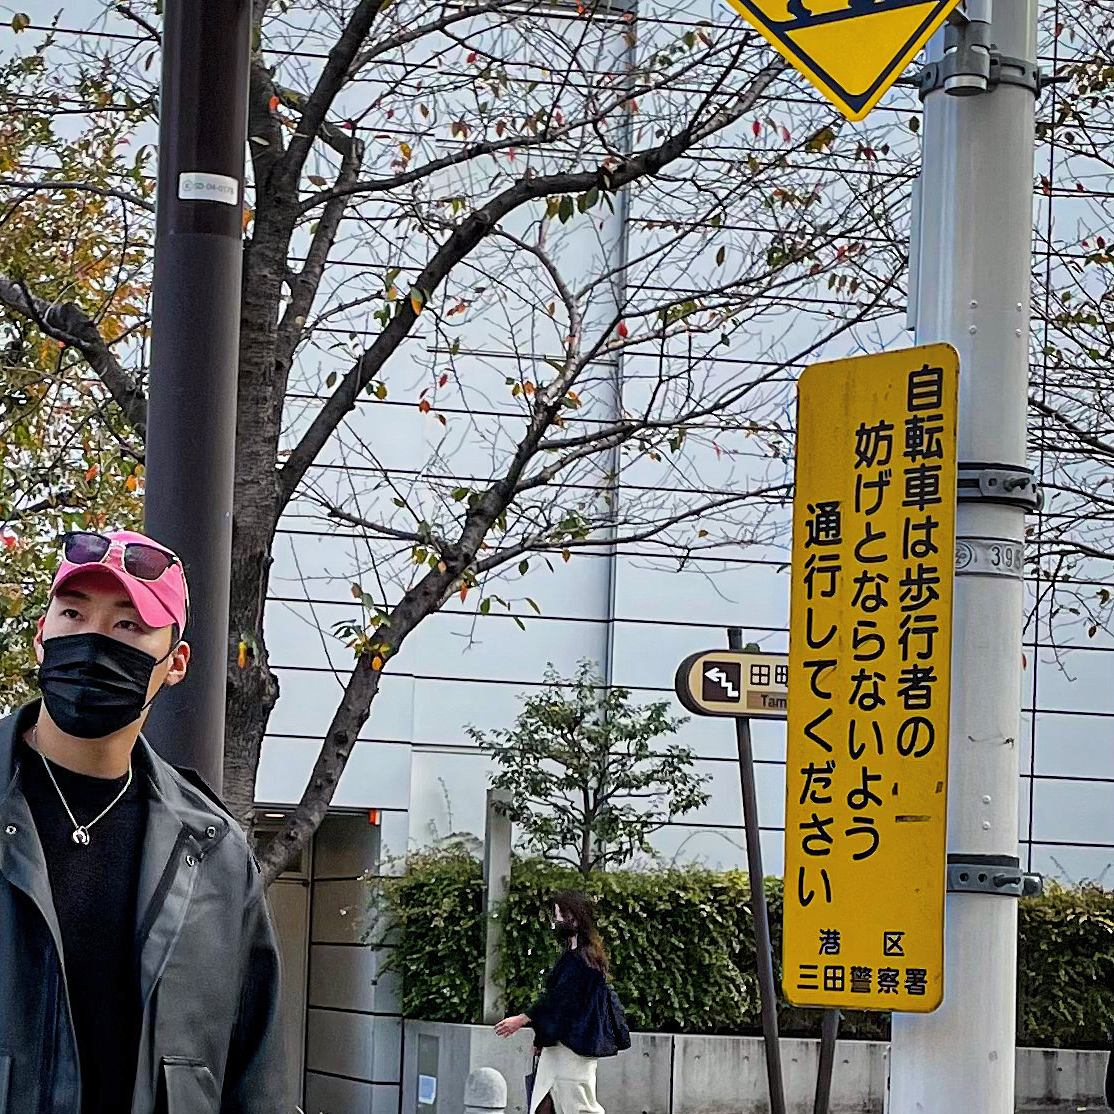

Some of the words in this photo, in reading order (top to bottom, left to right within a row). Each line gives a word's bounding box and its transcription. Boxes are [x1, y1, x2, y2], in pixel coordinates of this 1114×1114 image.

[797, 501, 842, 907] 通行してください
[845, 419, 894, 861] 妨げとならないよう
[896, 364, 944, 758] 自転車は歩行者の
[796, 963, 928, 996] 三田警察署
